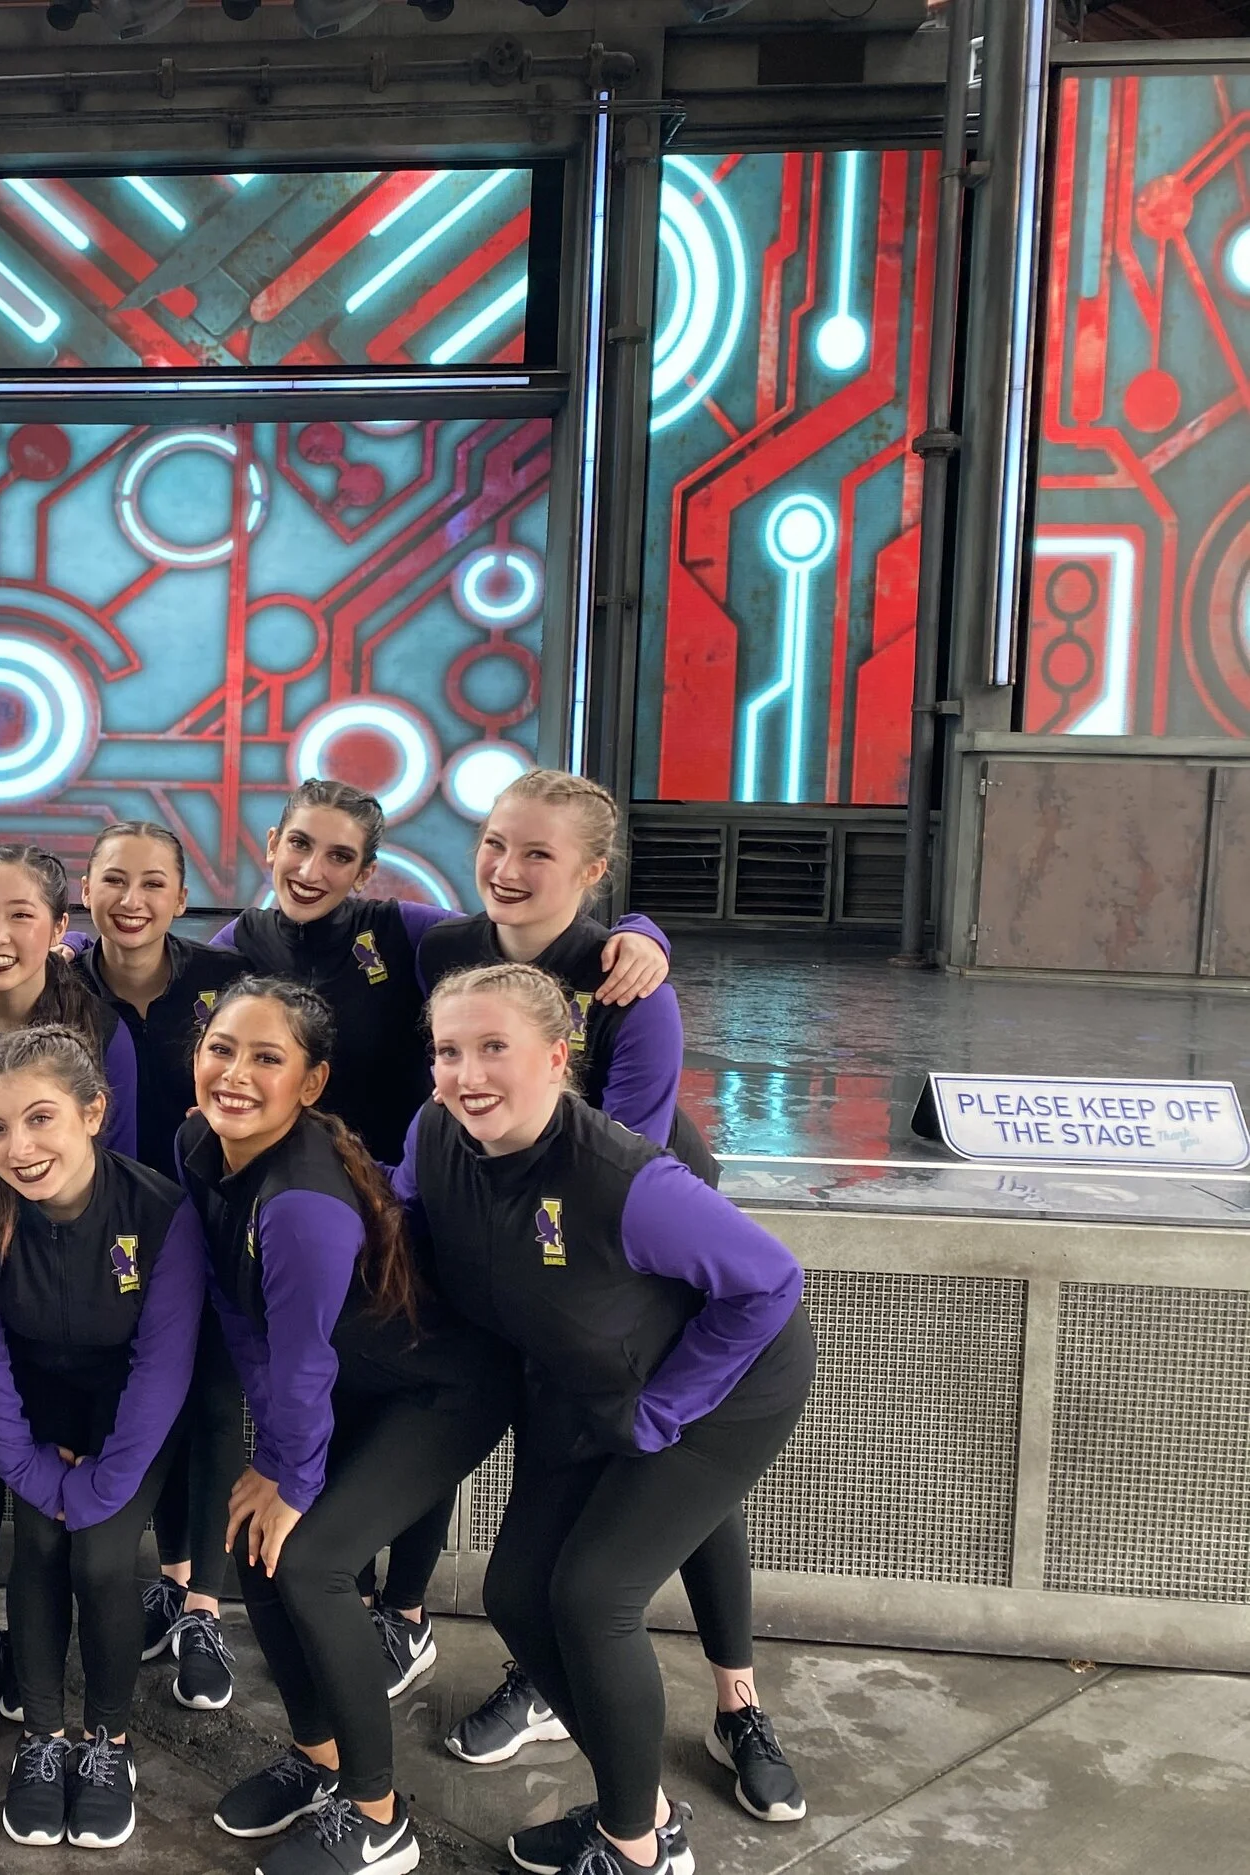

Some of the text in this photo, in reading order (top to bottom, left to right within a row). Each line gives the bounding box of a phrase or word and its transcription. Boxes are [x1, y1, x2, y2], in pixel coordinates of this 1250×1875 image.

[957, 1093, 1221, 1122] PLEASE KEEP OFF
[994, 1121, 1156, 1148] THE STAGE
[543, 1256, 567, 1266] DANCE
[120, 1283, 140, 1294] DANCE
